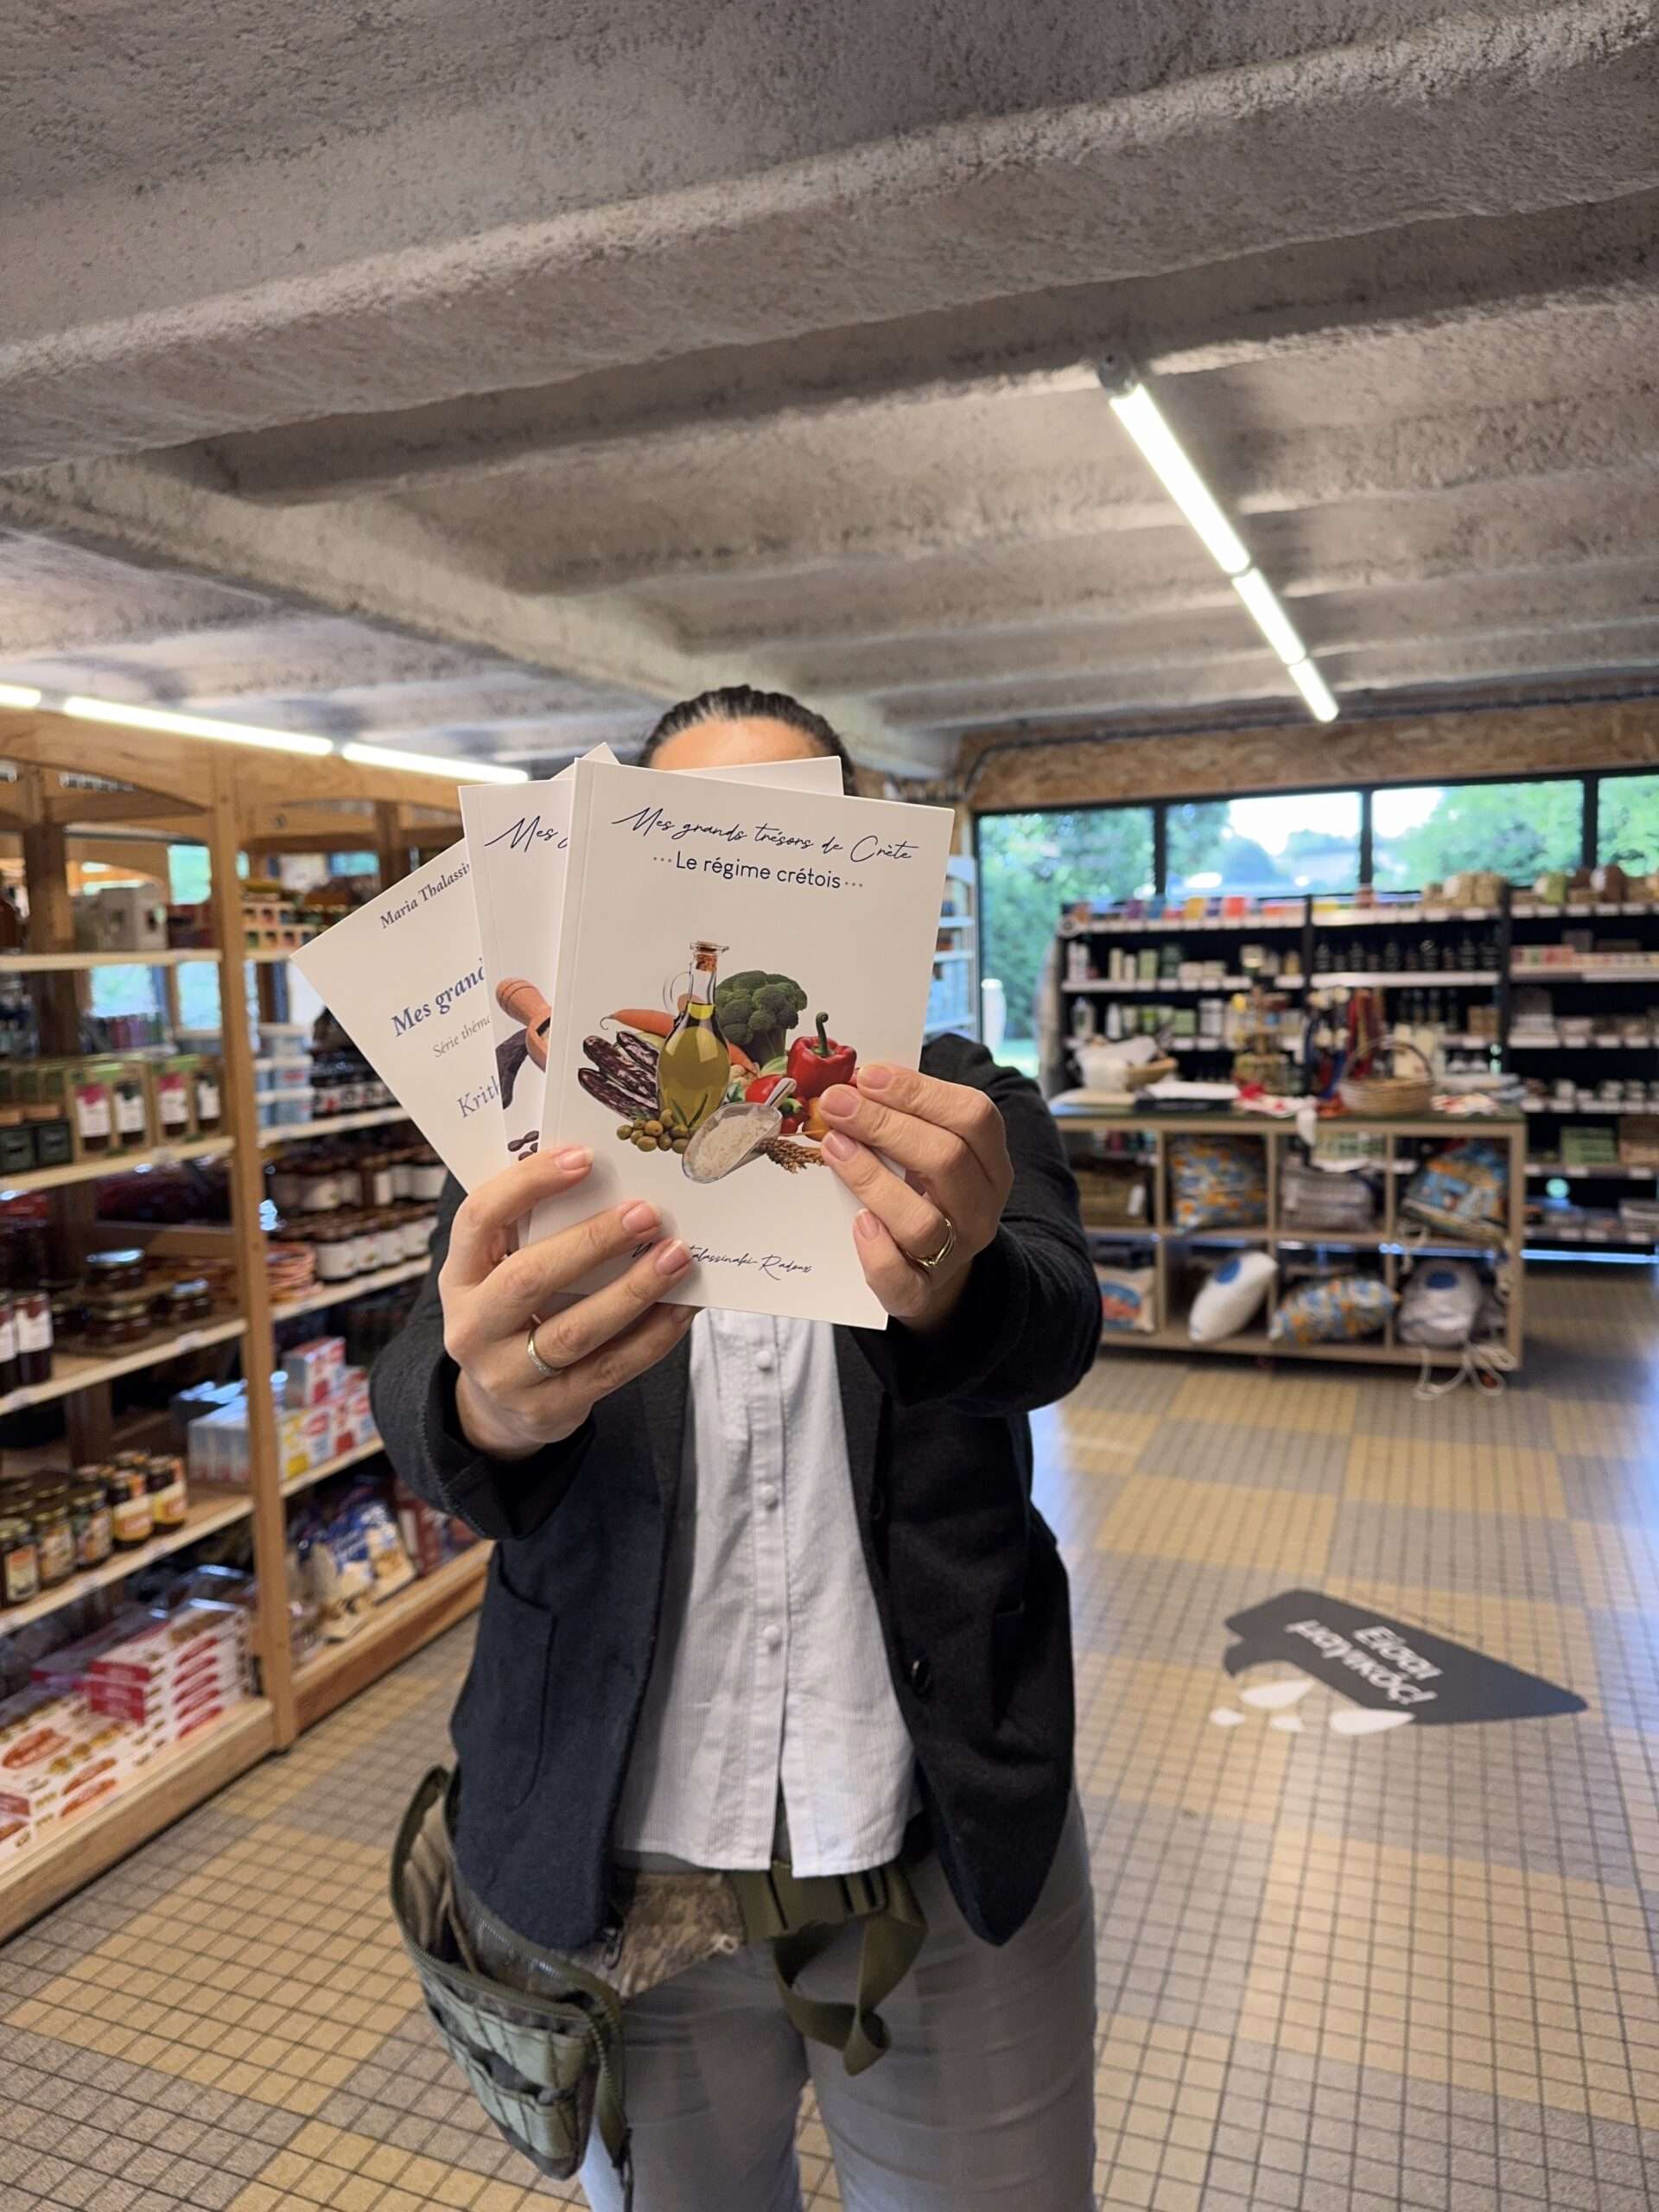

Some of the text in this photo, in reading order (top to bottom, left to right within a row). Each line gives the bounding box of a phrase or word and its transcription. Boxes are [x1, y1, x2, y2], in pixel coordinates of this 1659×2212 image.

[484, 815, 558, 853] Mes
[611, 807, 919, 862] Mes grands trésors de Crète
[703, 857, 771, 880] régime
[380, 898, 418, 929] Maria
[391, 1001, 432, 1037] Mes
[433, 1036, 459, 1058] Série
